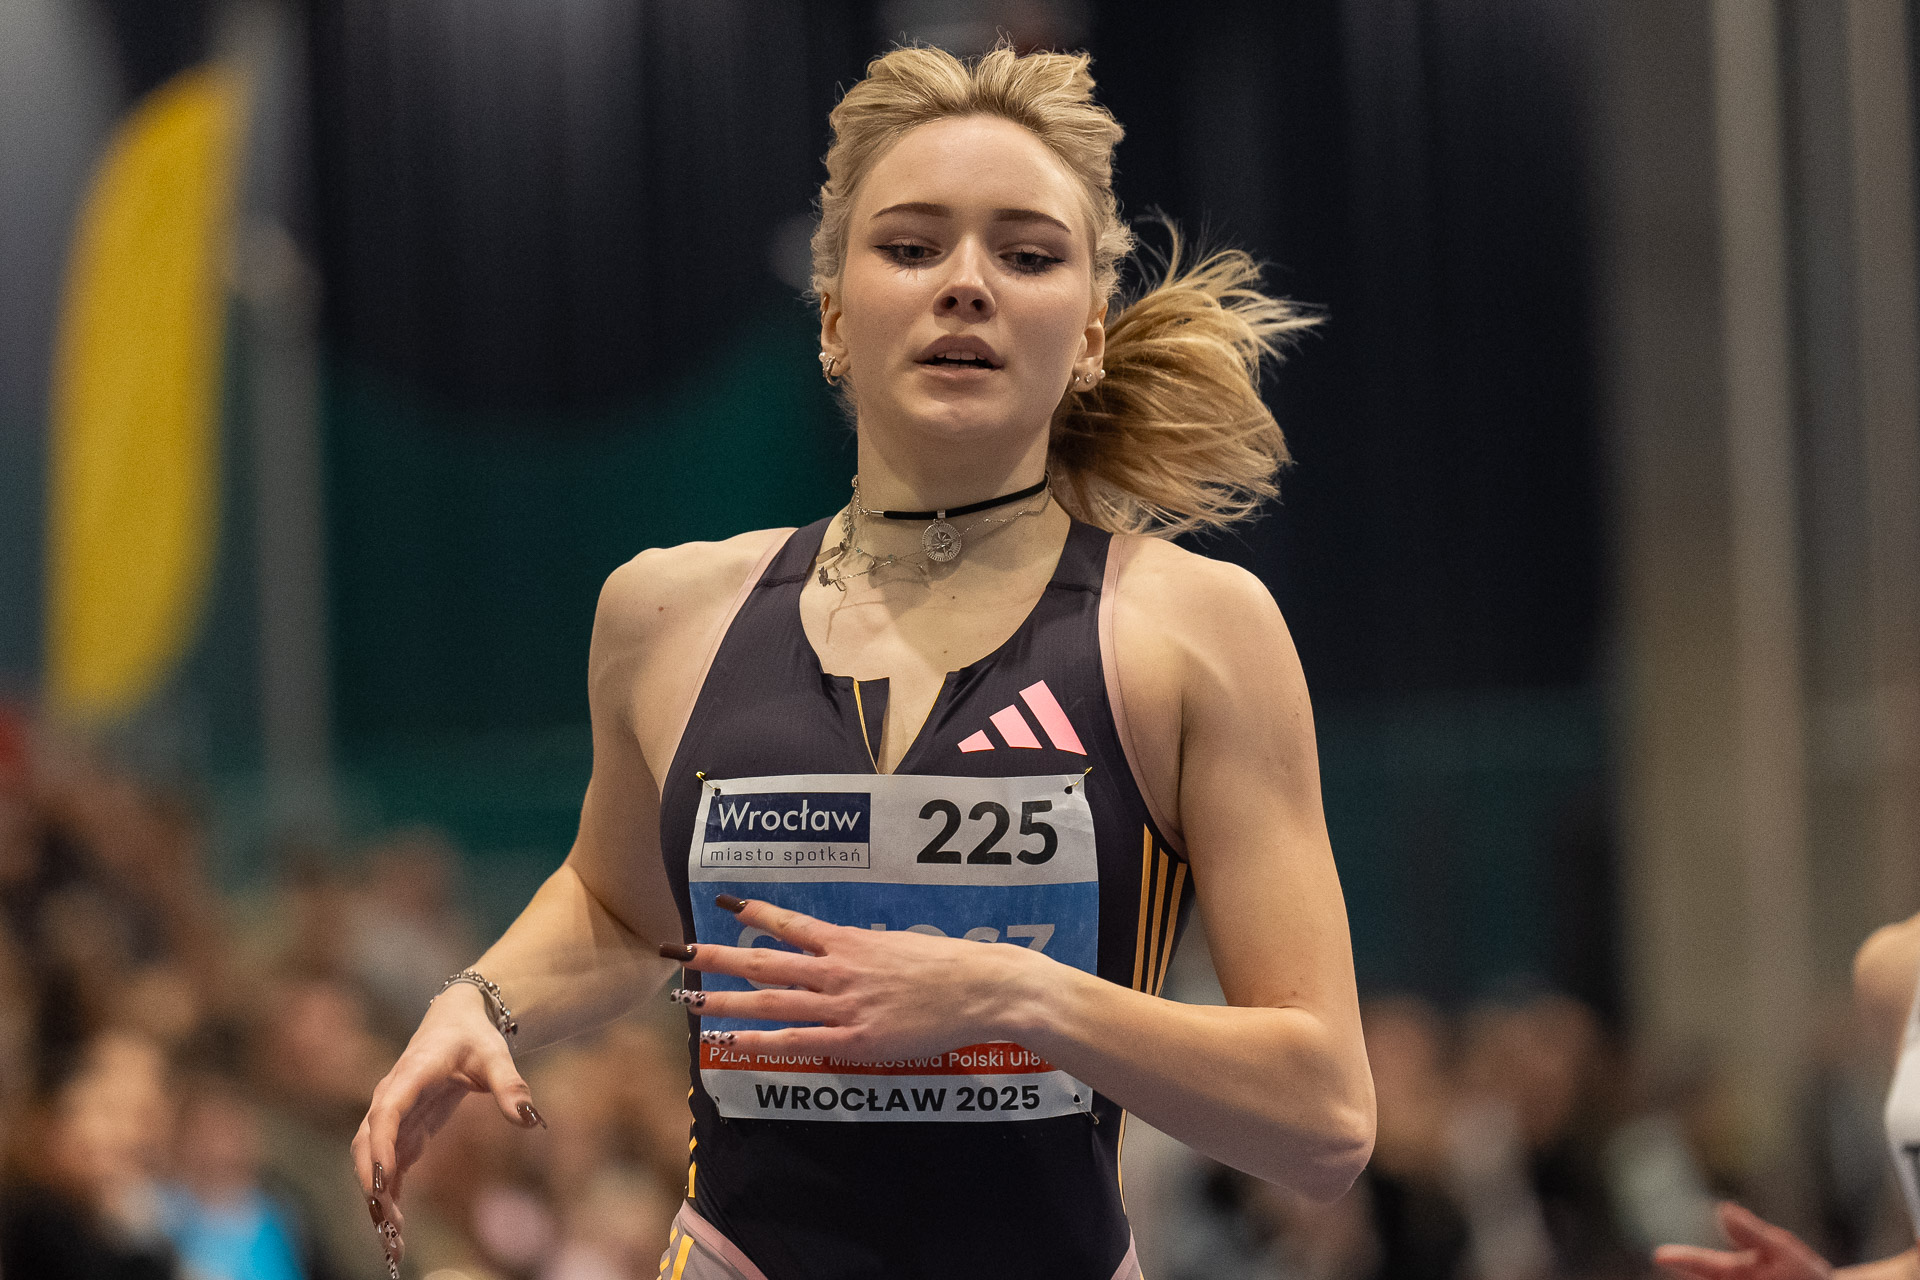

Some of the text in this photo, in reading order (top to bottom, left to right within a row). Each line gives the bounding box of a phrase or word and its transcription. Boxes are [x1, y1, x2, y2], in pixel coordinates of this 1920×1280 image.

[717, 799, 861, 832] Wrocław
[916, 798, 1059, 866] 225
[710, 845, 861, 866] miasto spotkań
[948, 1050, 1004, 1067] Polski
[1010, 1050, 1041, 1066] U18
[754, 1083, 1041, 1113] WROCŁAW 2025
